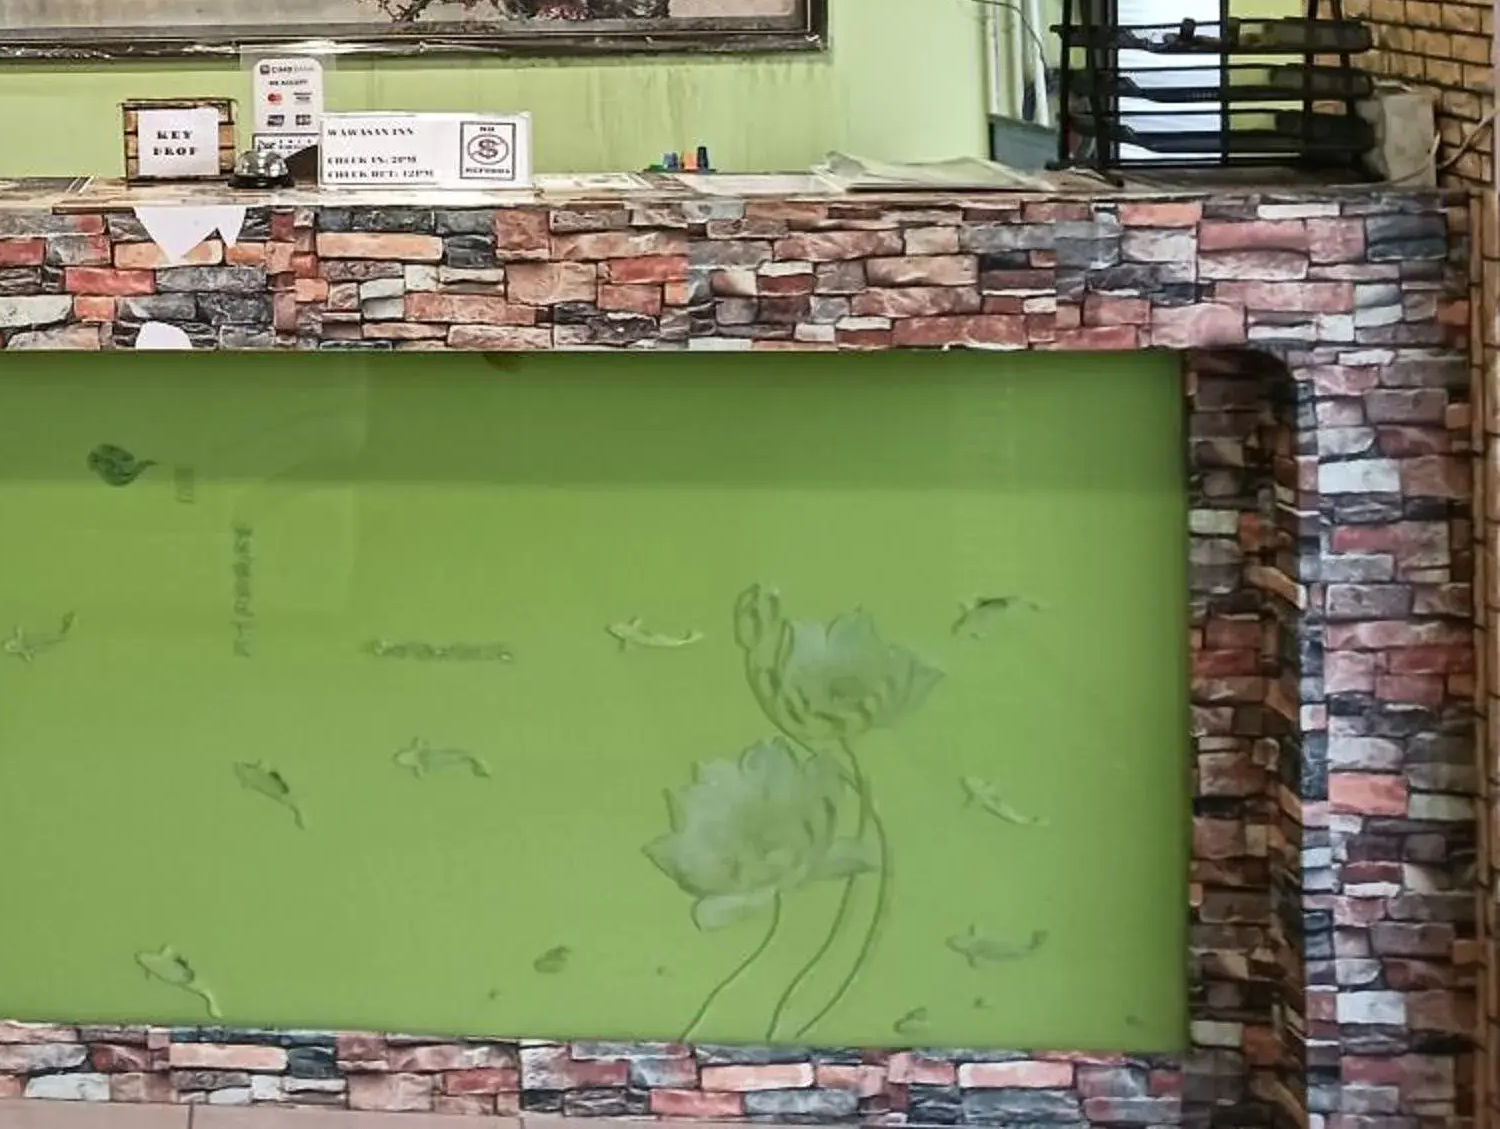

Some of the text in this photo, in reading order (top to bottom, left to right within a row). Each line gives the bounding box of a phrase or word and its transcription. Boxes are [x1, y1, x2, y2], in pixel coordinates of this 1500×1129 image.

[156, 130, 193, 140] KEY
[327, 156, 367, 165] CHECK
[327, 170, 367, 179] CHECK
